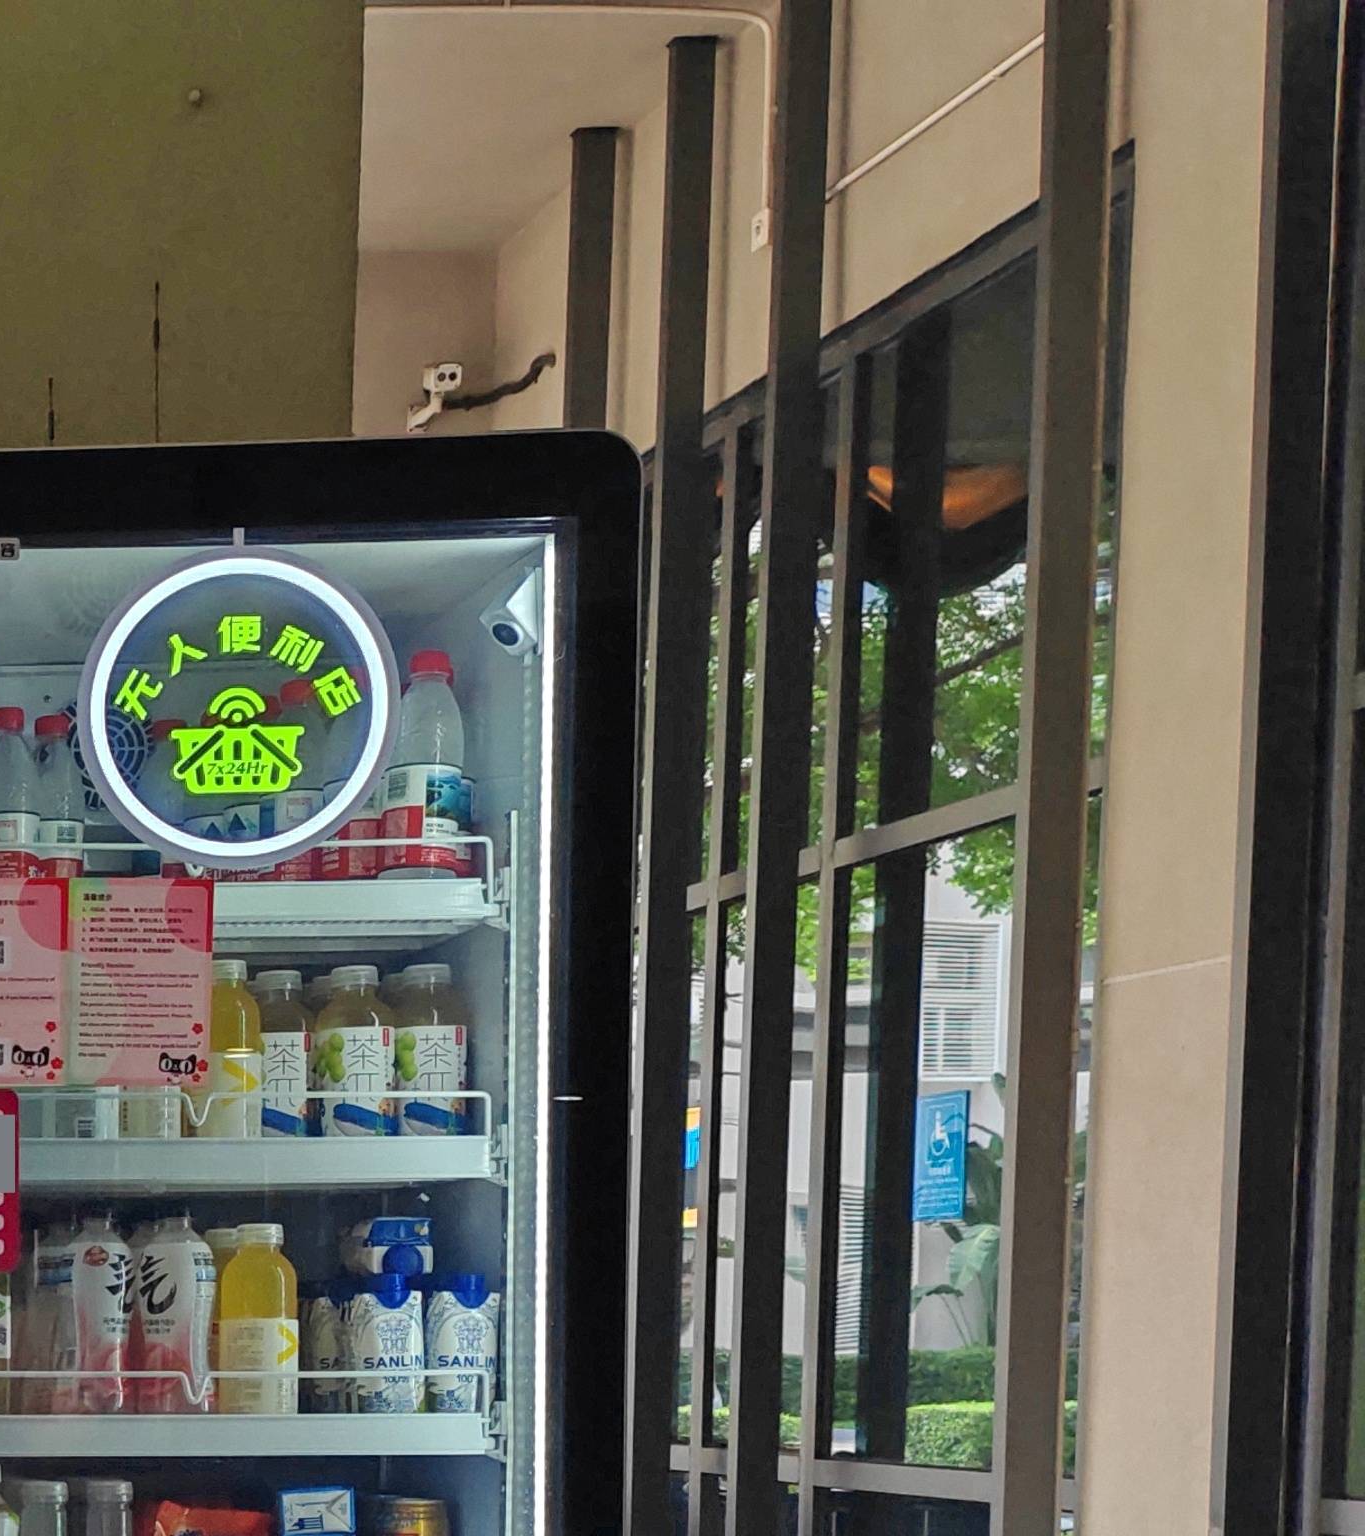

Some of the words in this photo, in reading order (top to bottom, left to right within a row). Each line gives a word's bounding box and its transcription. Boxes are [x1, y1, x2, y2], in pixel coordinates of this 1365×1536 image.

[114, 614, 363, 723] 无人便利店
[206, 759, 269, 778] 7x24Hr
